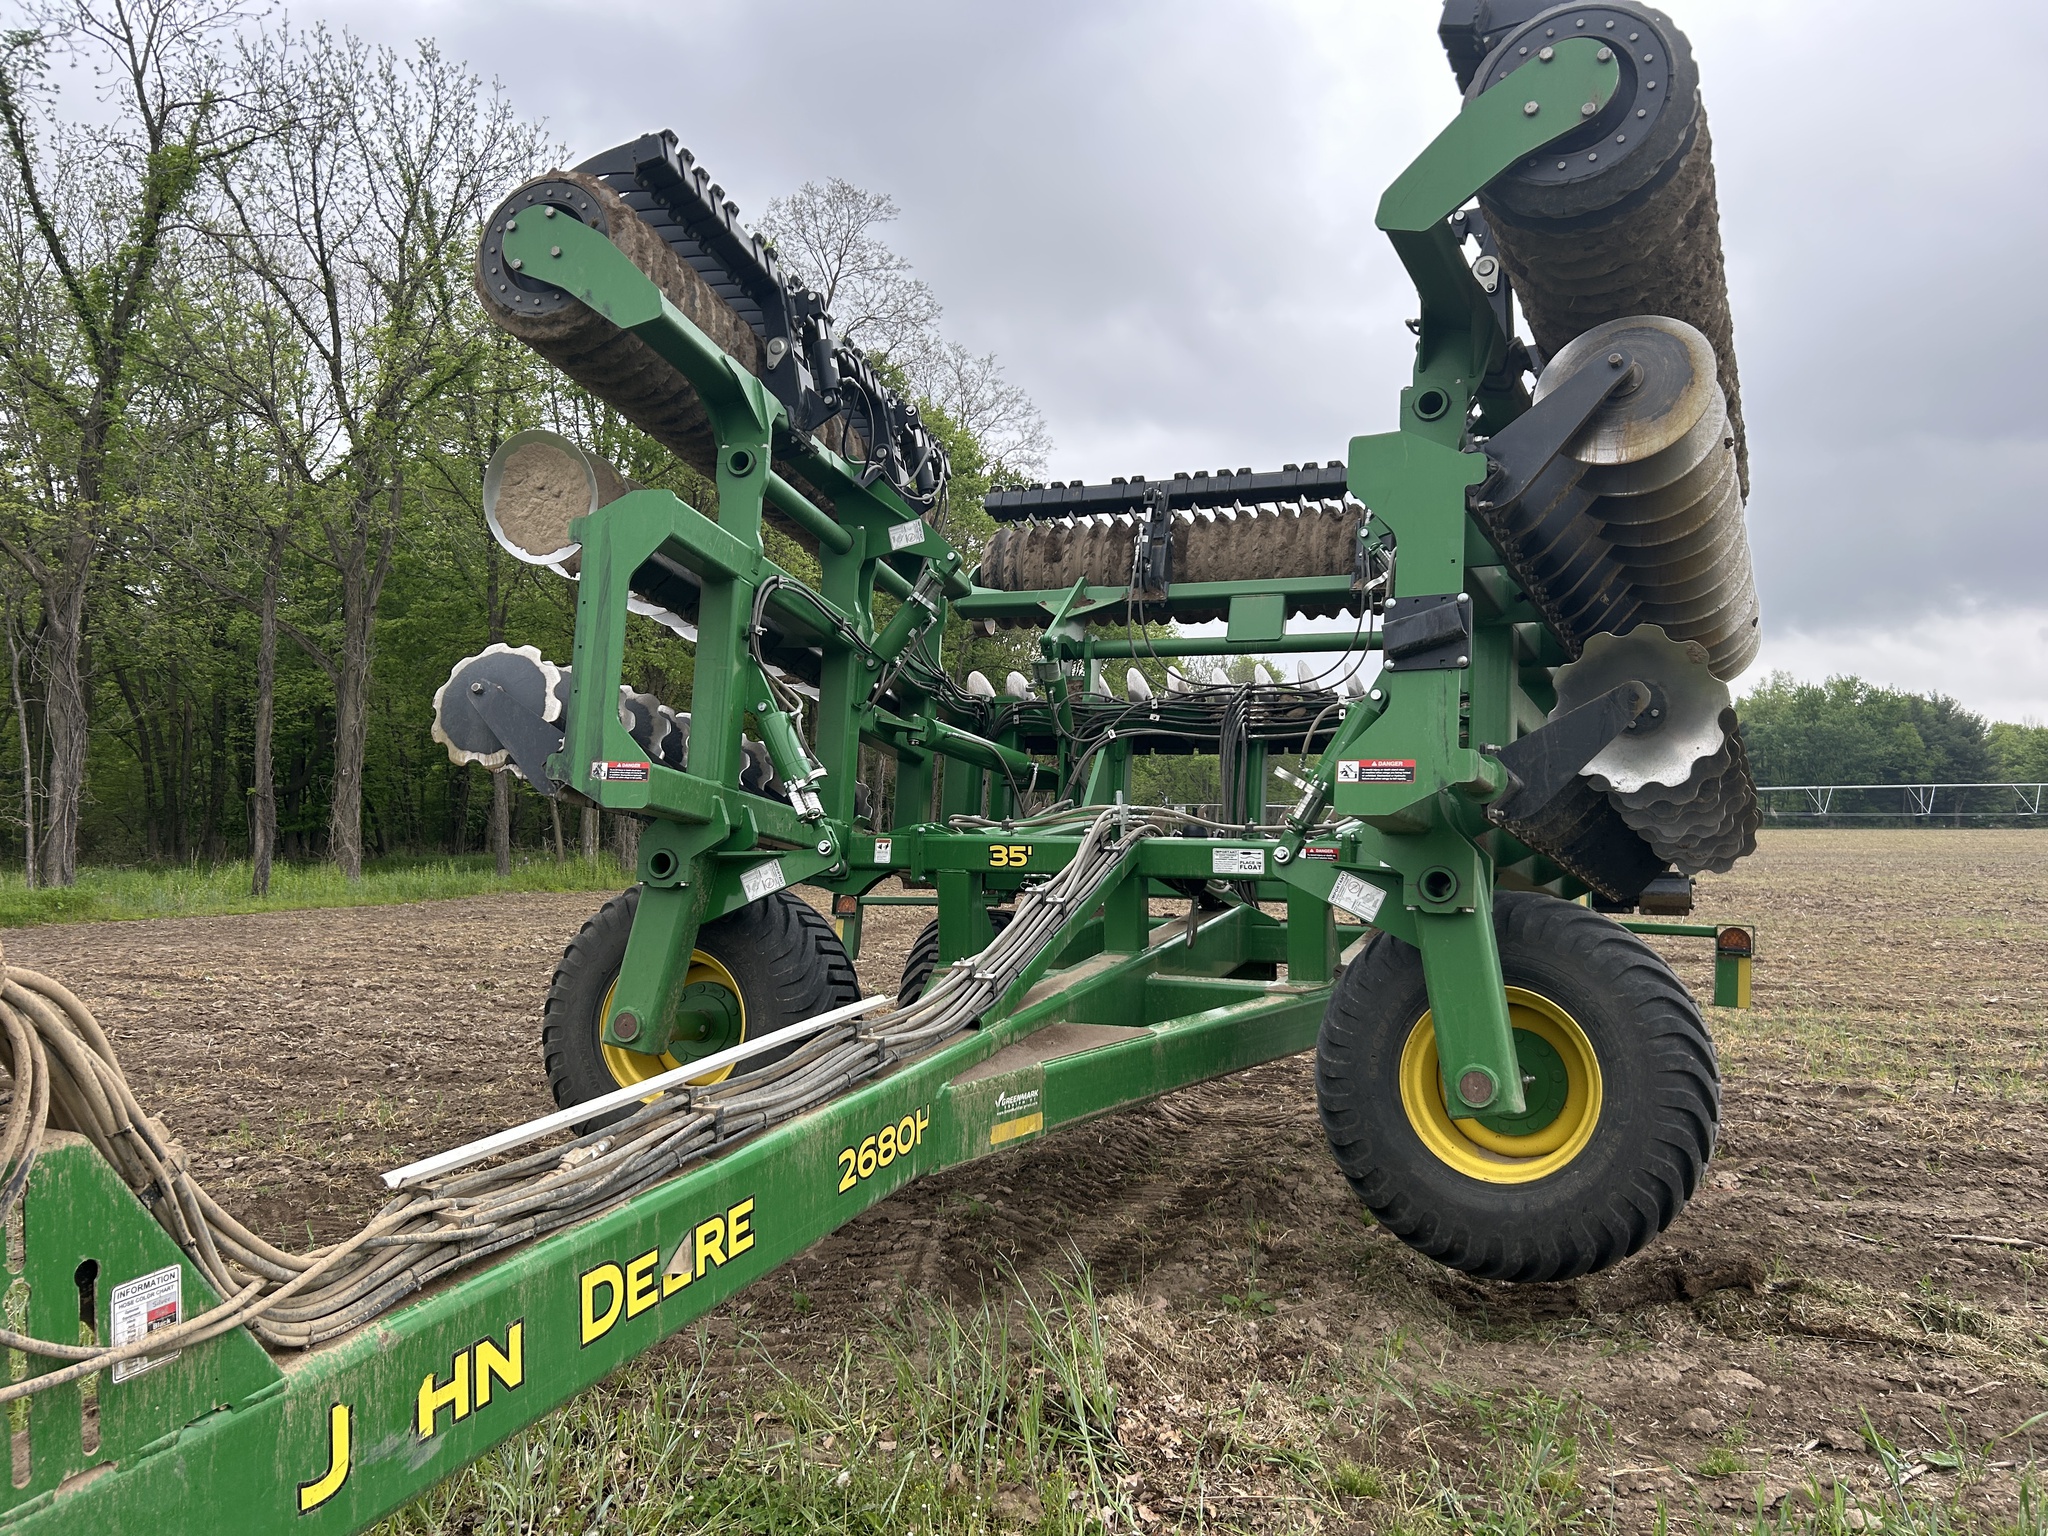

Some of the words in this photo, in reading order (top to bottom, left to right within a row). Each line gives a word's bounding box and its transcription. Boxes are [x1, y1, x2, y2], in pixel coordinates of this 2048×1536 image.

[1331, 873, 1346, 901] IMPORTANT
[1001, 1089, 1039, 1106] GREENMARK
[837, 1102, 931, 1197] 2680H
[116, 1271, 176, 1300] INFORMATION
[118, 1299, 134, 1310] HOSE
[135, 1291, 155, 1303] COLOR
[155, 1284, 175, 1296] CHART
[152, 1296, 171, 1308] Silver
[152, 1318, 171, 1330] Black
